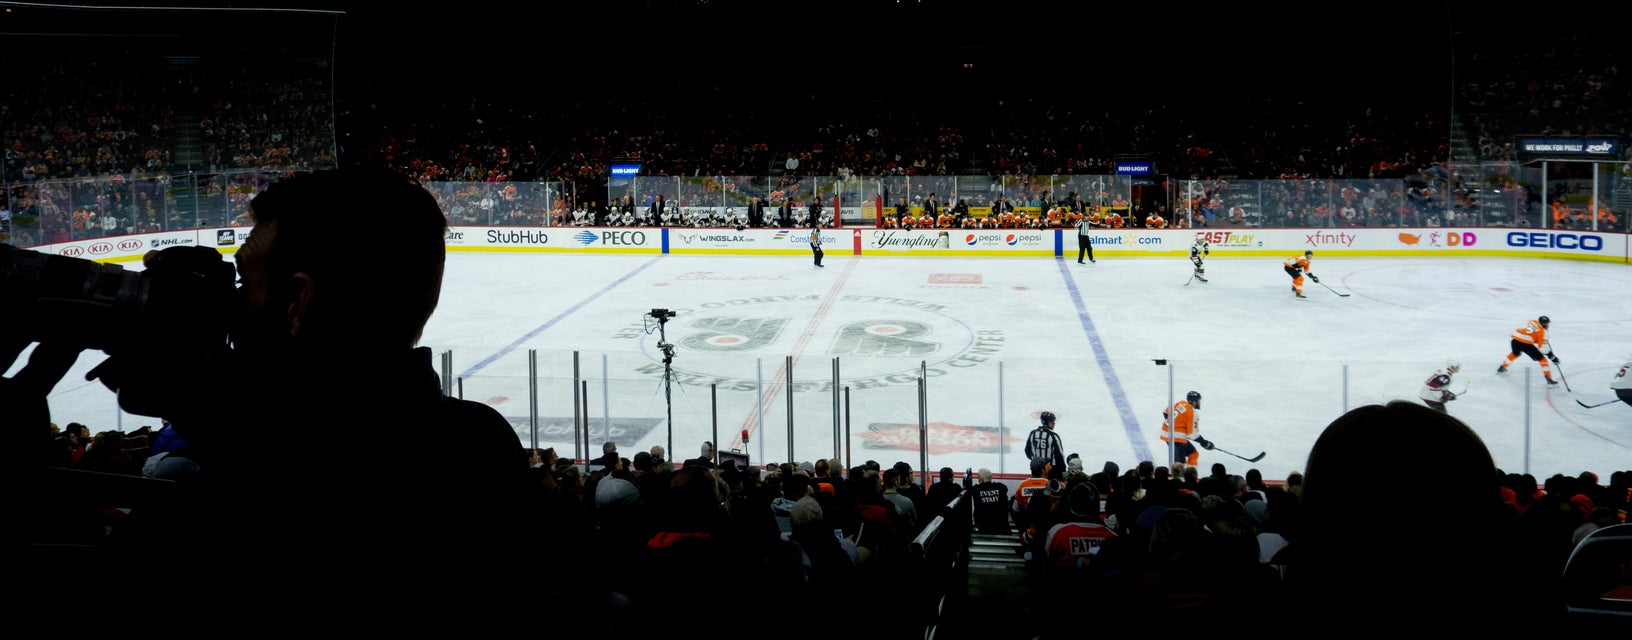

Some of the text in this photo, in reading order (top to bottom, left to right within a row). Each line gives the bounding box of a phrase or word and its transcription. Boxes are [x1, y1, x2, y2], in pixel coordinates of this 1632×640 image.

[487, 229, 548, 244] StubHub
[602, 231, 646, 246] PECO
[871, 230, 939, 249] Yuengling
[978, 233, 1001, 242] pepsi
[1018, 233, 1042, 242] pepsi
[1089, 235, 1123, 245] almart
[1305, 231, 1356, 247] xfinity
[1507, 232, 1603, 250] GEICO
[91, 245, 109, 253] KIA
[120, 241, 138, 249] KIA
[62, 248, 80, 256] KIA
[947, 328, 1006, 368] CENTER
[1035, 438, 1046, 449] 76
